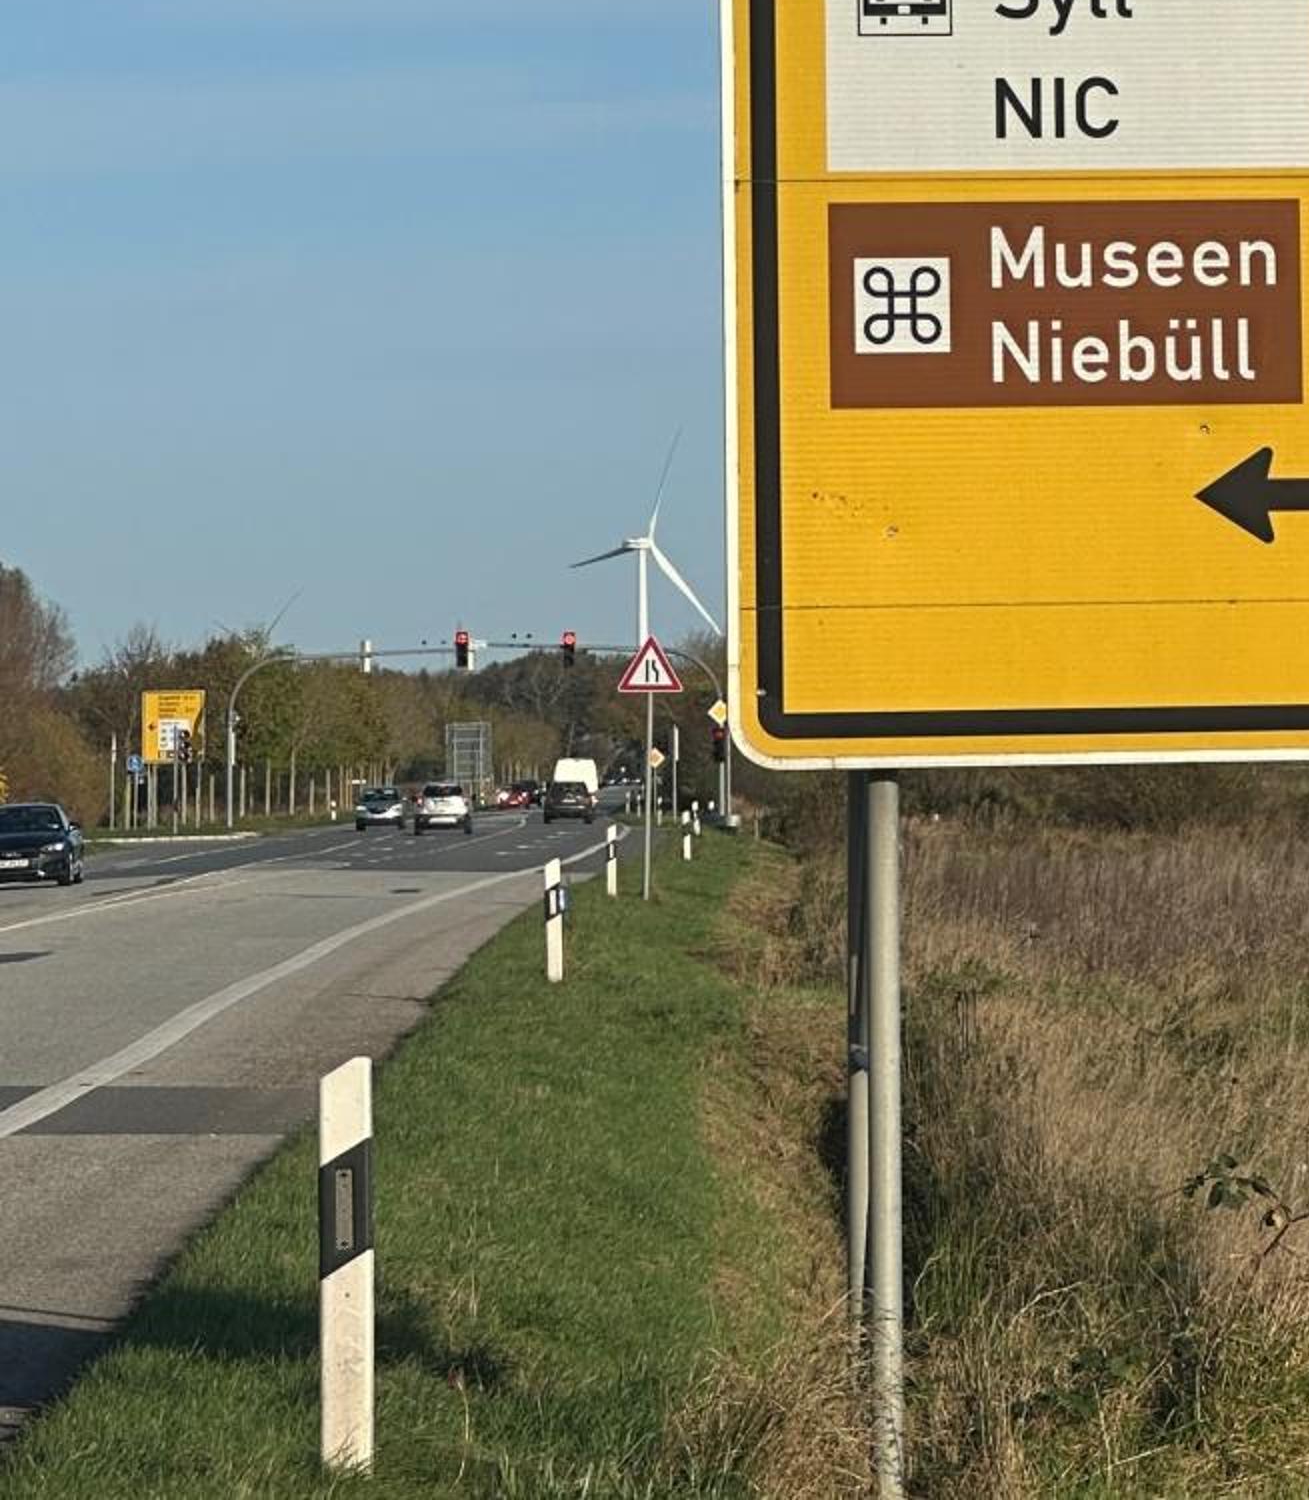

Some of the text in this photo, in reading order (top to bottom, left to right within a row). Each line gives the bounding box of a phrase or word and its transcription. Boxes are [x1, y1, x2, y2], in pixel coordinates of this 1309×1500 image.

[995, 77, 1119, 139] NIC
[991, 226, 1277, 288] Museen
[991, 318, 1255, 383] Niebüll
